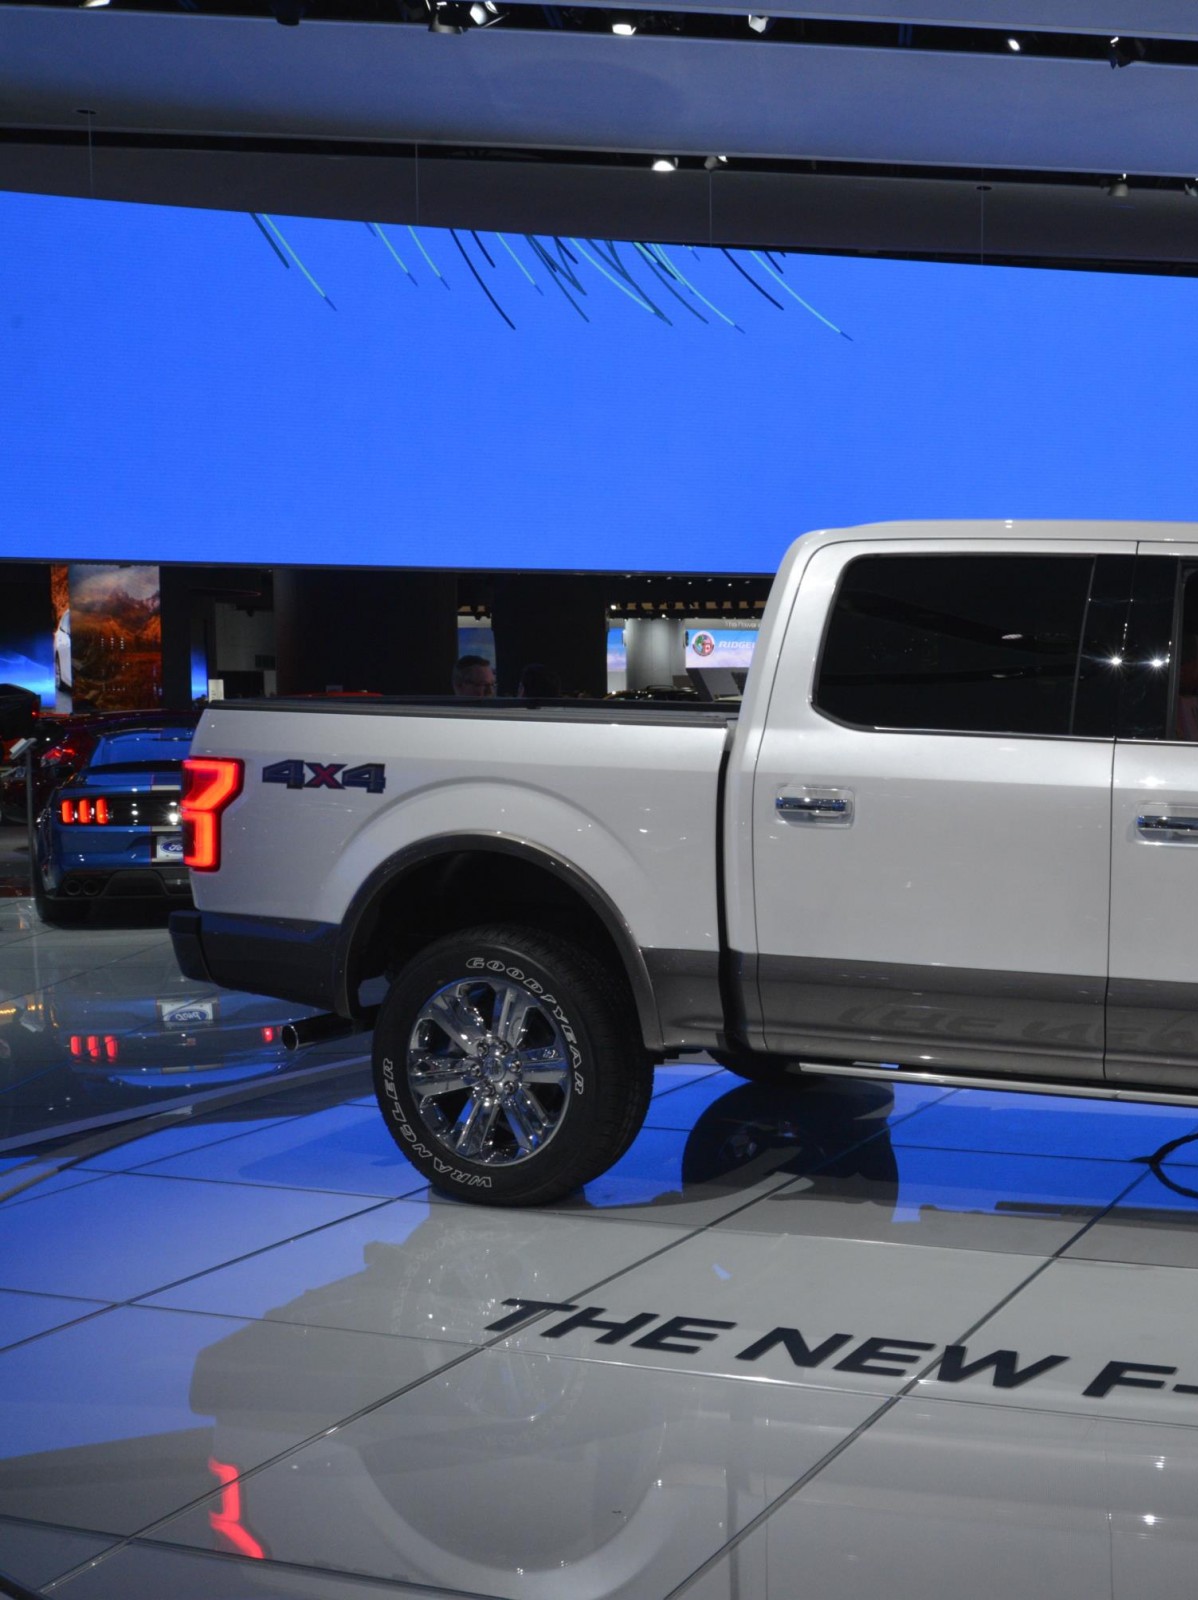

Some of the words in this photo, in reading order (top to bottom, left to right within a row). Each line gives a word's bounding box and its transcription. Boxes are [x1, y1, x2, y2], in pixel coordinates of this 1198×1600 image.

[382, 1057, 493, 1188] WRANGLER
[484, 1298, 738, 1354] THE
[735, 1326, 1070, 1389] NEW
